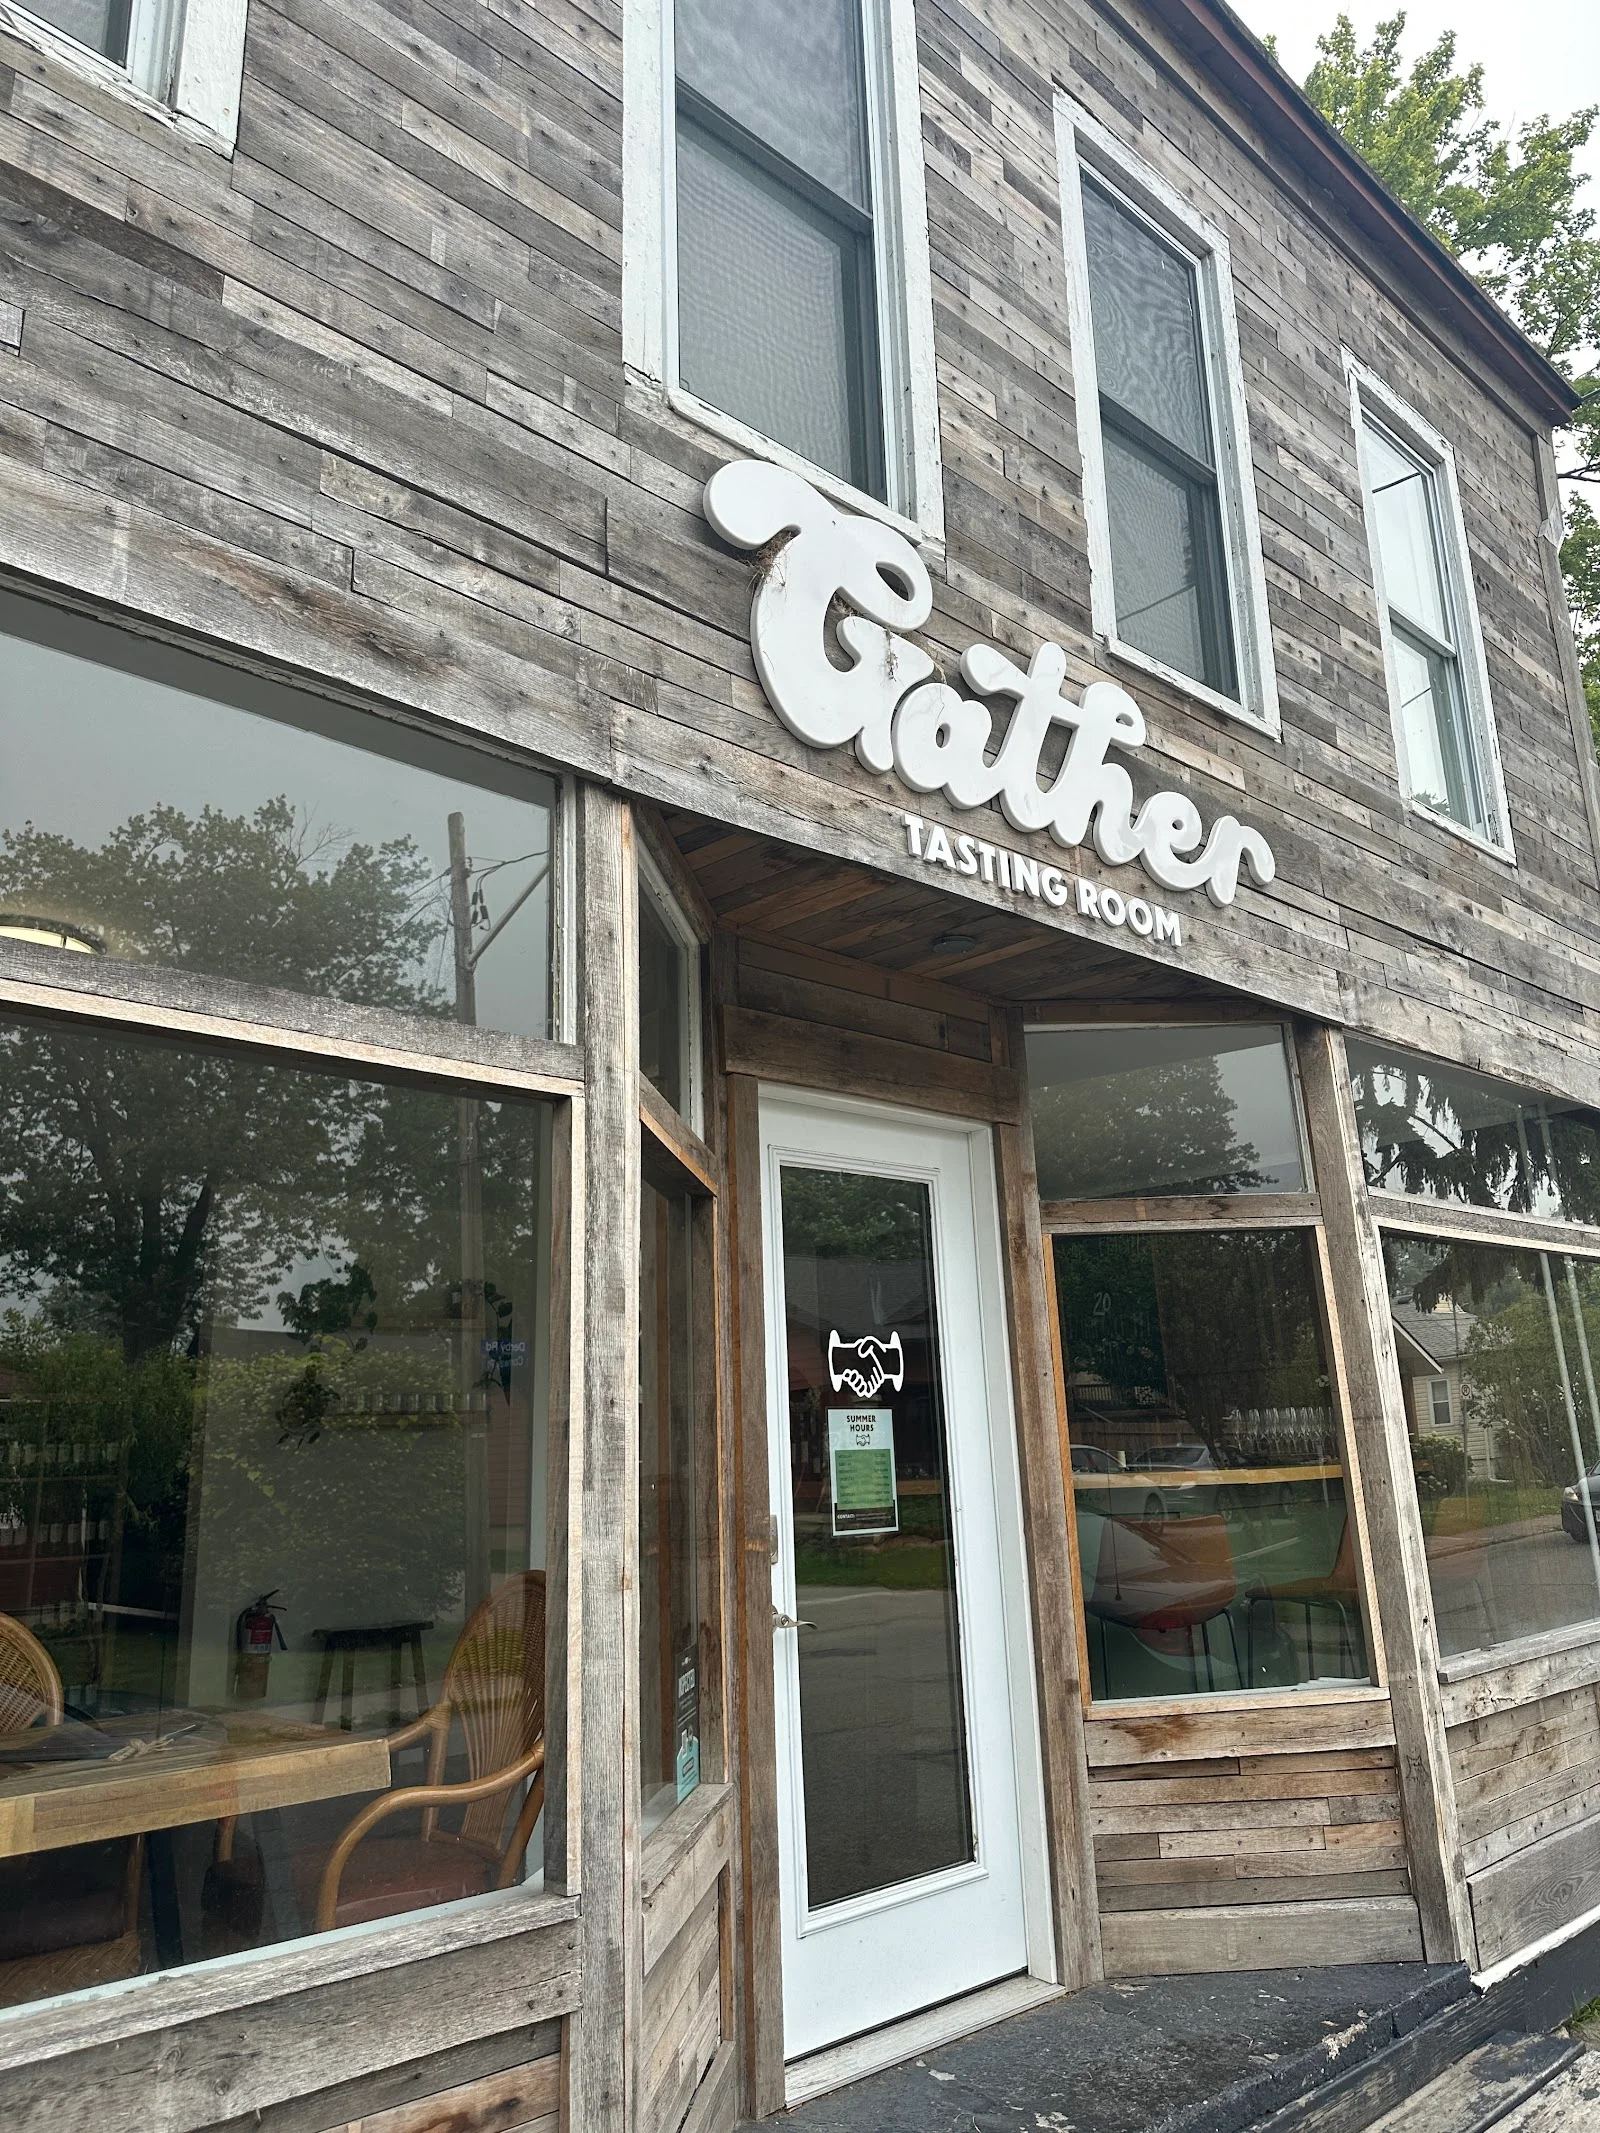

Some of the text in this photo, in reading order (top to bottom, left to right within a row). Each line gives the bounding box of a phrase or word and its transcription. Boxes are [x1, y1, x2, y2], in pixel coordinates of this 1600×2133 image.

[702, 459, 1276, 908] Gather
[901, 812, 1183, 948] TASTING ROOM
[847, 1415, 876, 1423] SUMMER
[850, 1424, 874, 1432] HOURS
